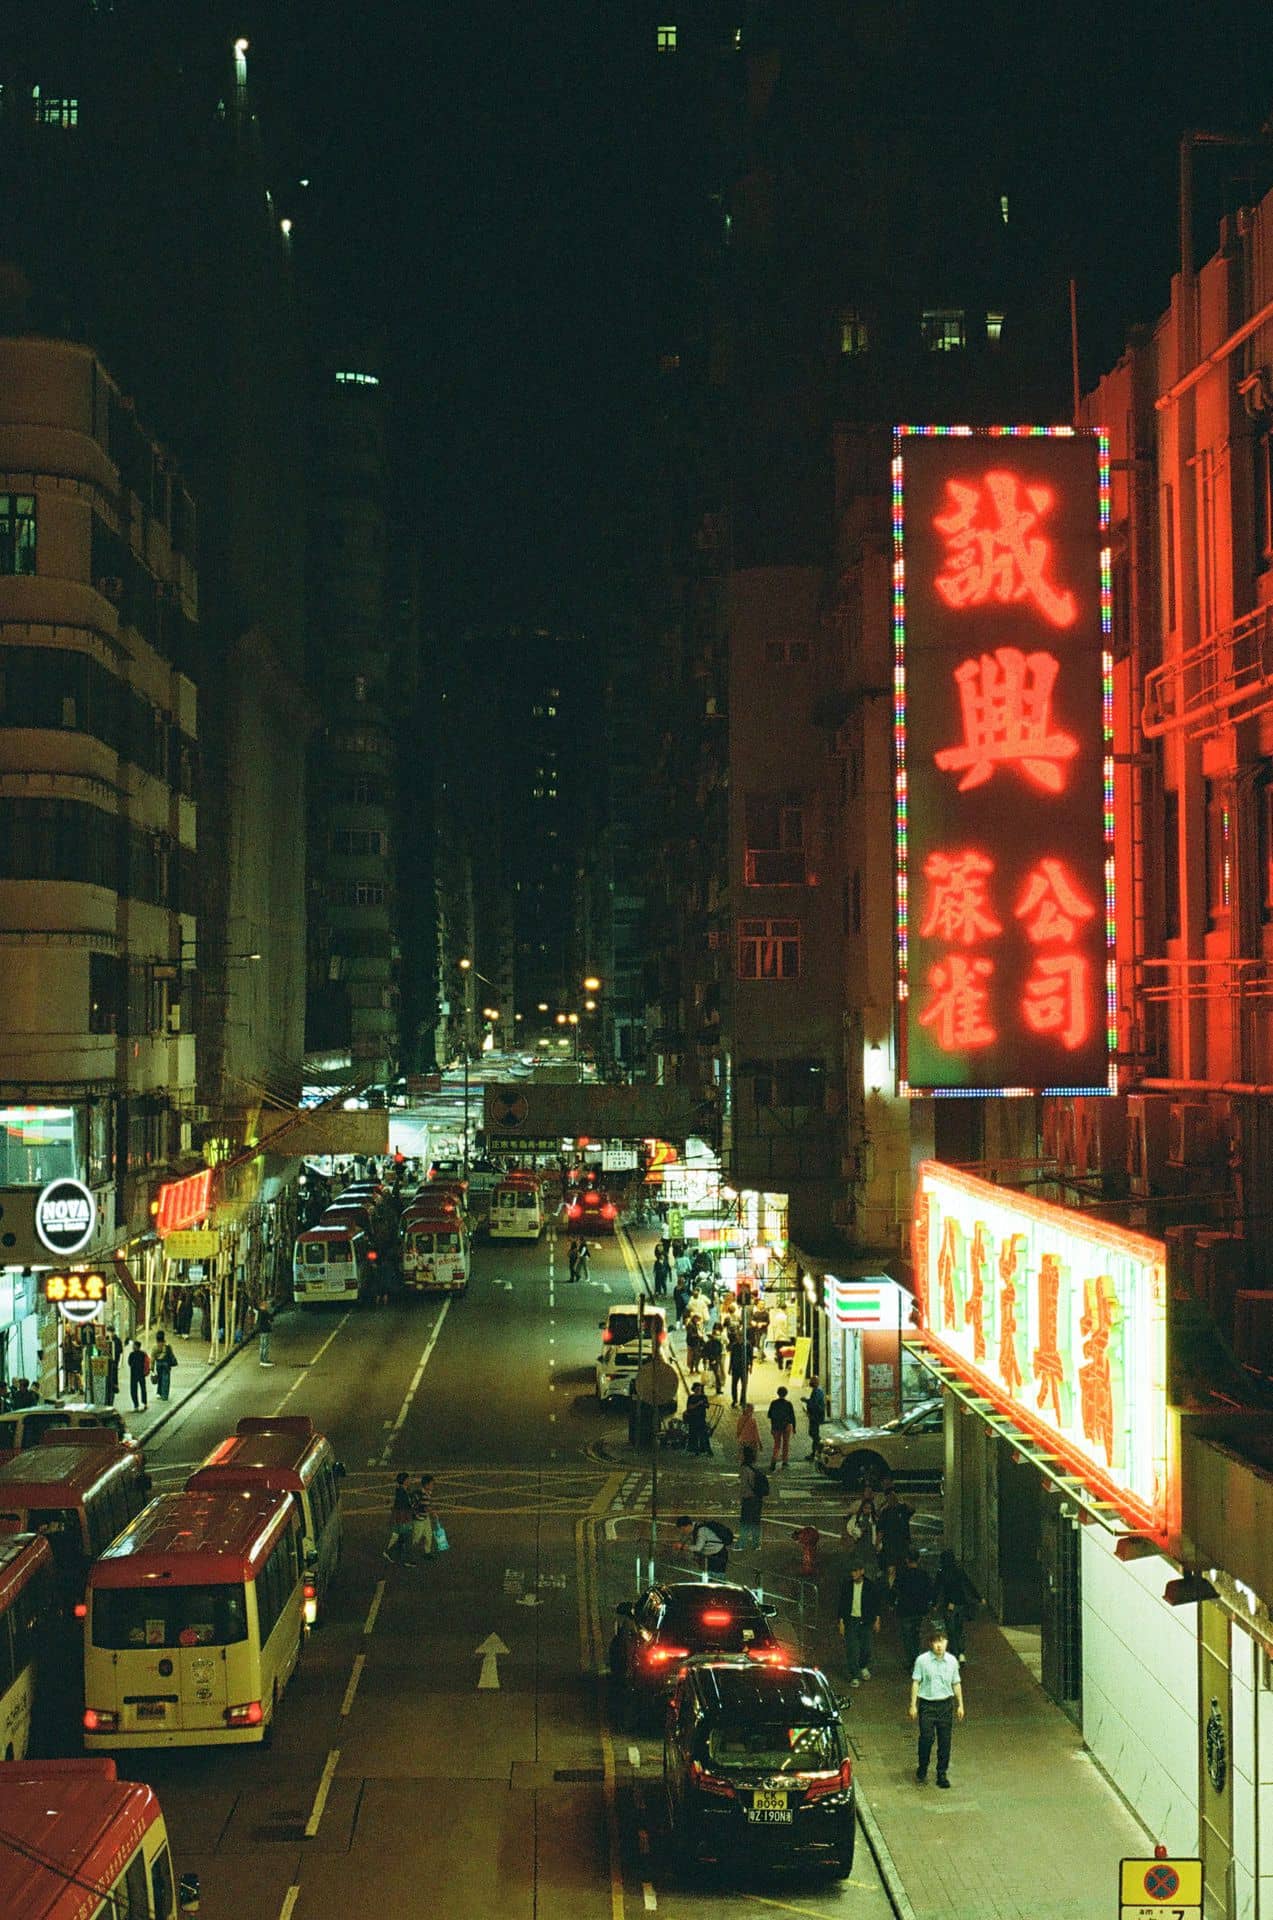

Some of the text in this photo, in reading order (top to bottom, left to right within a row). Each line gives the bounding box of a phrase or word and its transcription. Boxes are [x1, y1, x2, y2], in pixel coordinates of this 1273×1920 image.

[933, 471, 1077, 794] 誠興
[1014, 859, 1096, 1052] 公司
[43, 1200, 89, 1219] NOVA
[757, 1800, 784, 1808] 8099
